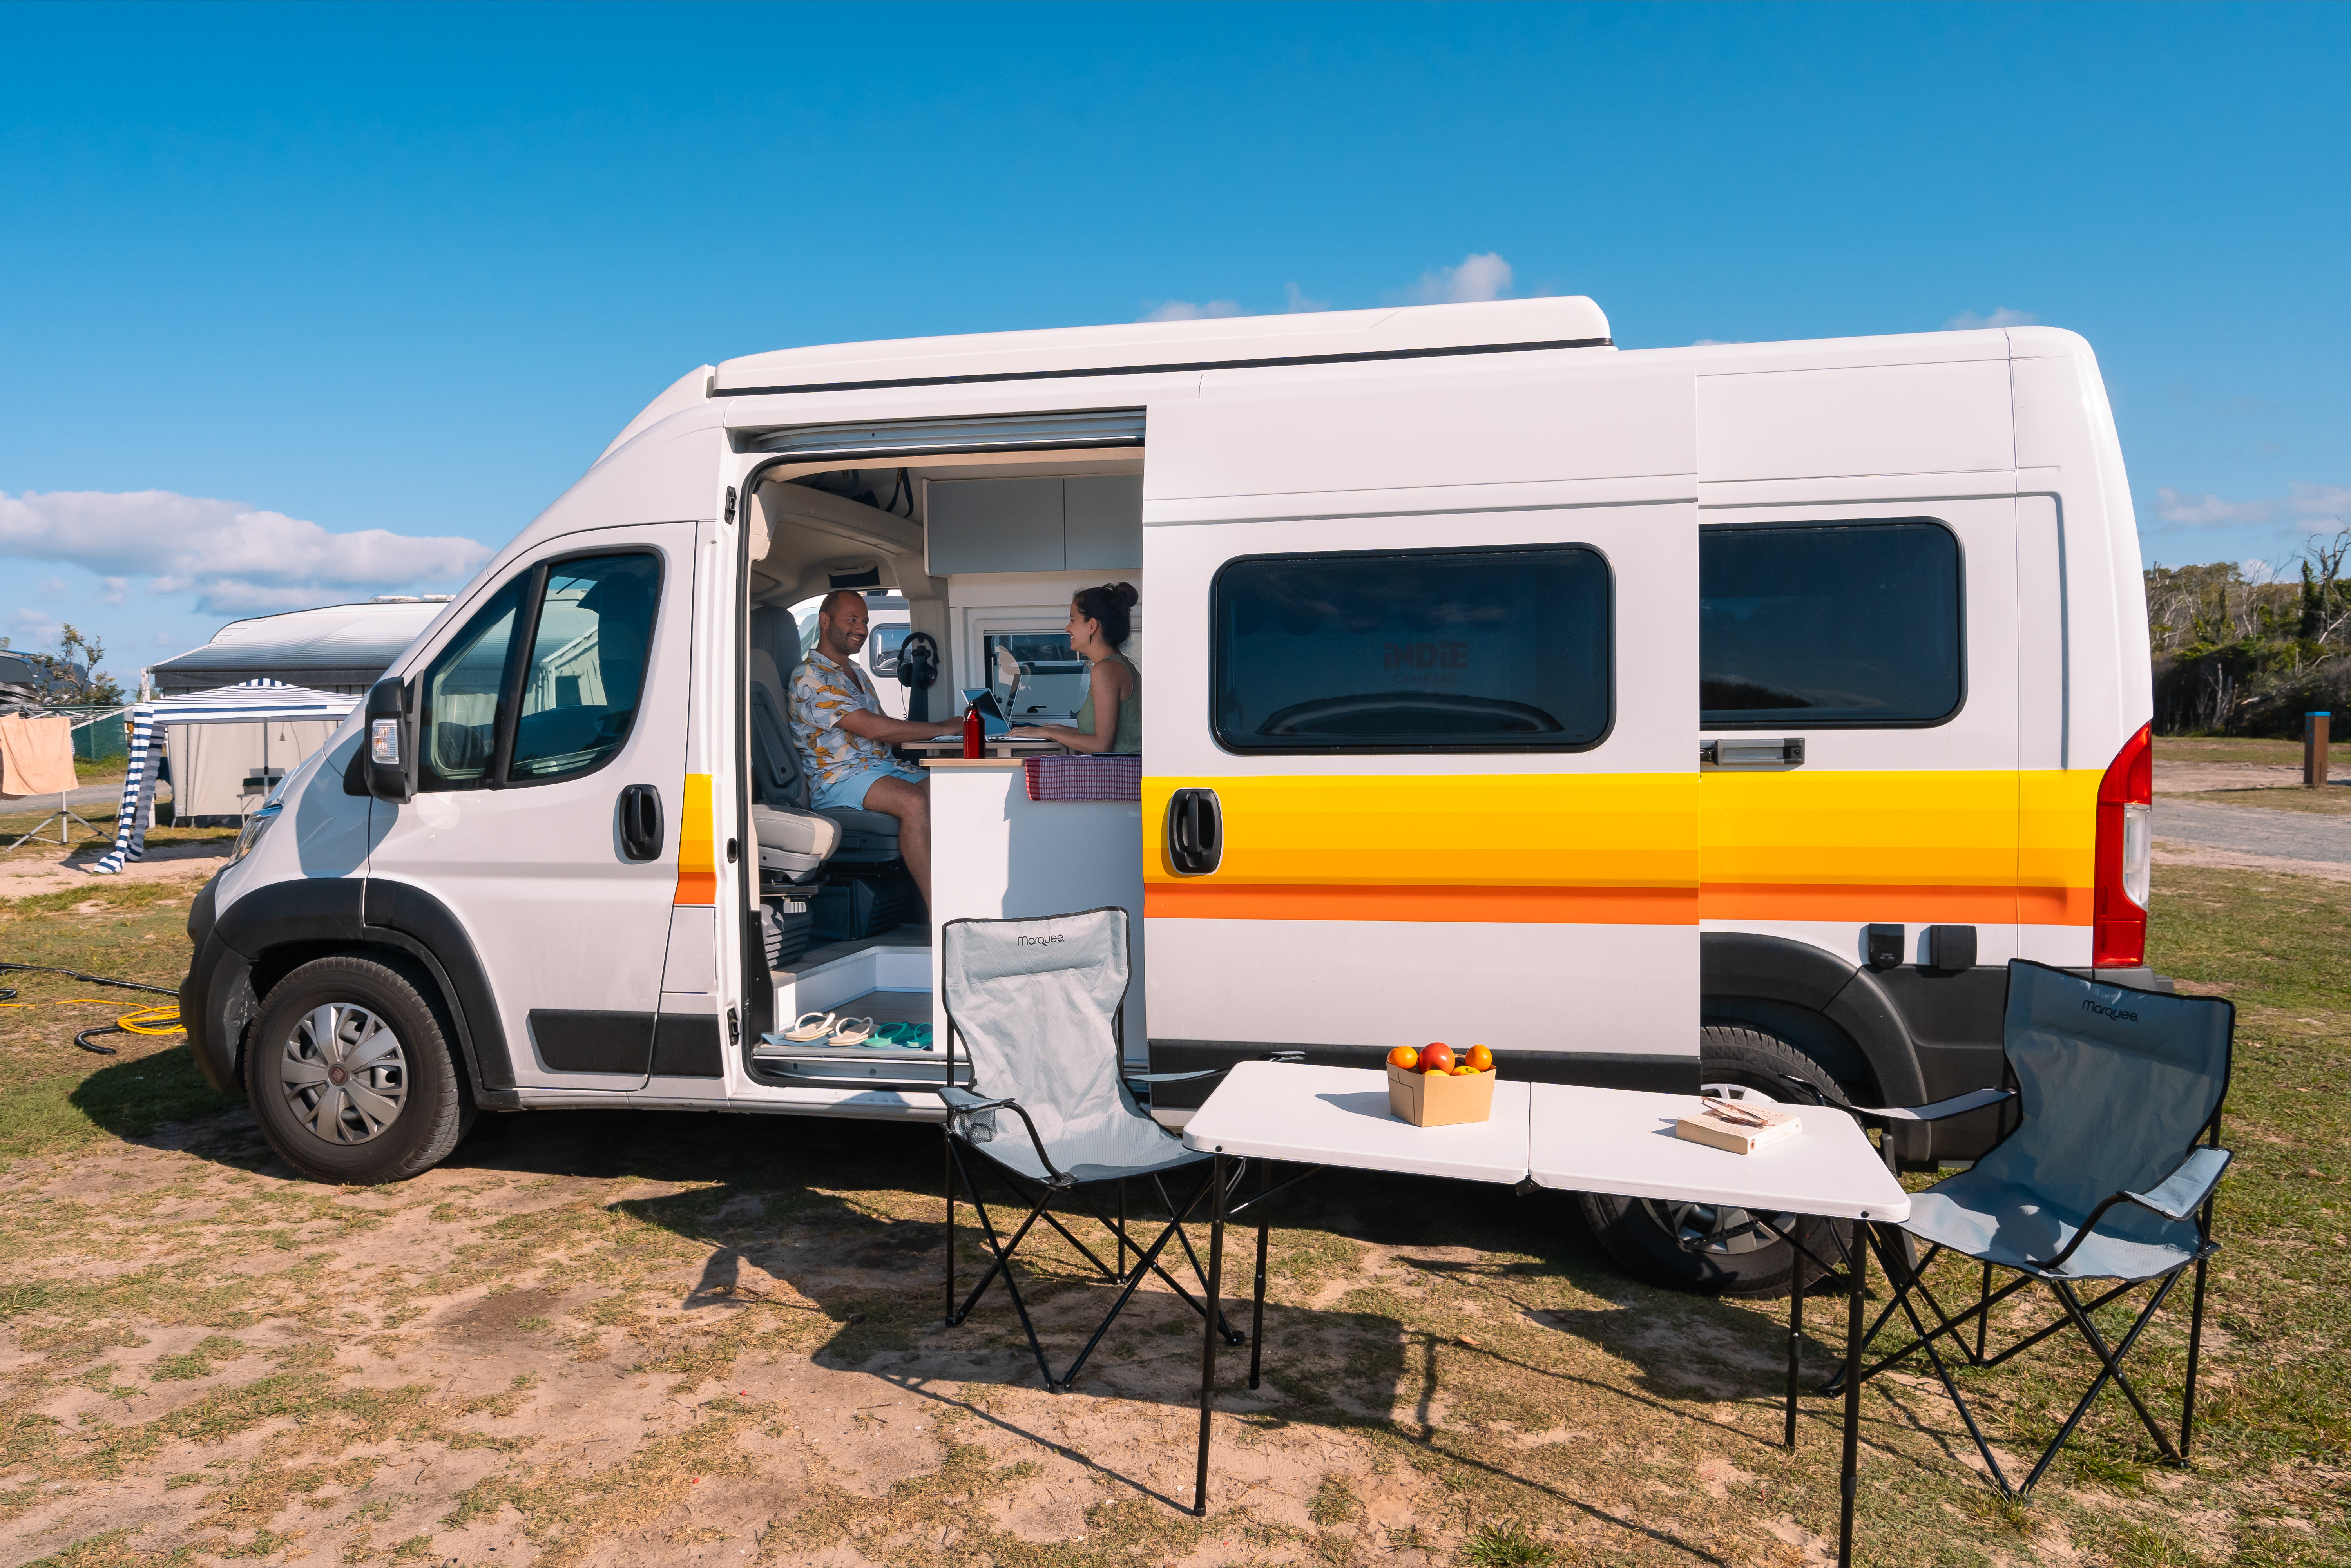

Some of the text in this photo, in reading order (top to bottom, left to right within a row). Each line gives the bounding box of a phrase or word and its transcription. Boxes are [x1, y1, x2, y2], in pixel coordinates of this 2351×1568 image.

[1393, 673, 1458, 684] CAMPERS
[332, 1068, 344, 1082] FIAT
[1735, 1105, 1770, 1114] Century
